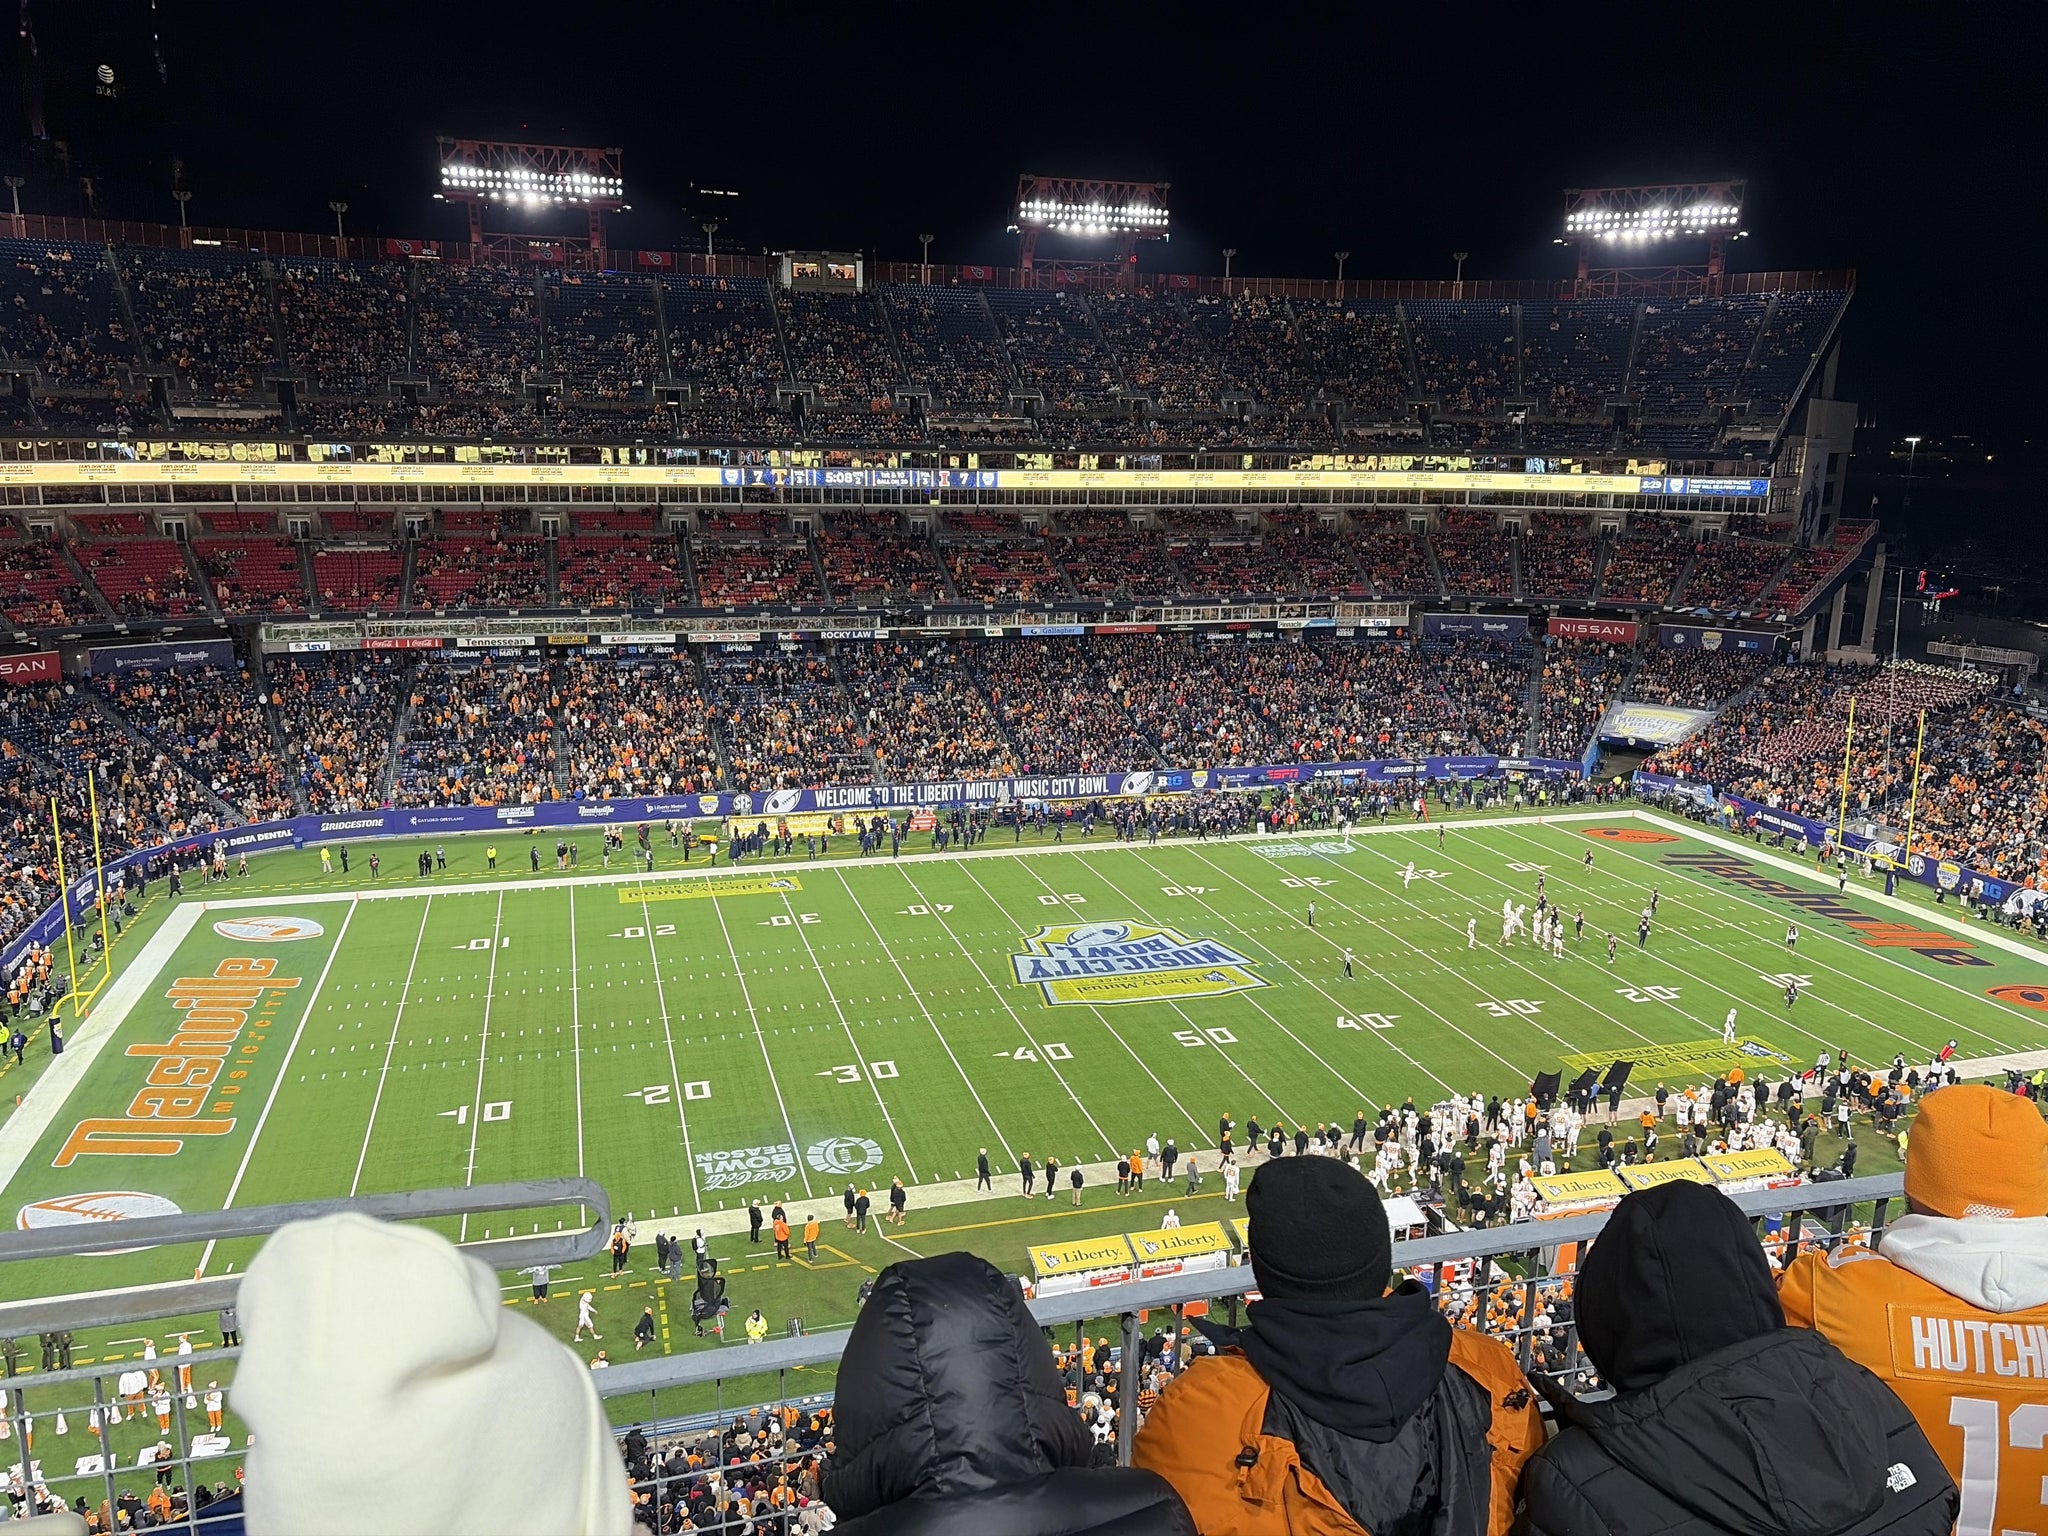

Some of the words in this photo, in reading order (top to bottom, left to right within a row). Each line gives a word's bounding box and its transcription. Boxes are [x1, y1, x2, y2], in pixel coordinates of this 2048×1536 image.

[753, 470, 763, 482] 7
[825, 472, 853, 483] 5:08
[959, 472, 969, 485] 7
[821, 631, 850, 639] ROCKY
[852, 631, 871, 639] LAW
[1042, 627, 1075, 635] Gallagher
[1559, 623, 1625, 636] NISSAN
[1267, 769, 1299, 780] ESPN
[815, 787, 870, 808] WELCOME
[871, 787, 889, 804] TO
[892, 785, 914, 803] THE
[918, 782, 962, 802] LIBERTY
[1013, 778, 1049, 797] MUSIC
[1052, 777, 1075, 796] CITY
[1079, 776, 1109, 794] BOWL
[735, 798, 750, 808] SEC
[320, 819, 384, 832] BRIDGESTONE
[1763, 814, 1782, 826] DELTA
[1782, 819, 1805, 833] DENTAL
[230, 833, 257, 847] DELTA
[257, 829, 293, 842] DENTAL
[1911, 859, 1924, 872] SEC
[1056, 938, 1169, 958] BOWL
[1117, 944, 1236, 970] MUSIC
[1029, 957, 1115, 979] CITY
[1077, 981, 1138, 994] Mutual
[1140, 976, 1202, 990] Liberty
[1615, 985, 1675, 1002] 20
[1476, 999, 1540, 1017] 30
[1336, 1012, 1396, 1030] 40
[1171, 1027, 1239, 1048] 50
[211, 1044, 260, 1114] MUSIC
[254, 990, 287, 1029] CITY
[1012, 1042, 1075, 1063] 40
[51, 957, 302, 1167] Nashville
[832, 1060, 900, 1084] 30
[643, 1080, 712, 1105] 20
[457, 1101, 513, 1125] 10
[695, 1144, 792, 1163] SEASON
[696, 1152, 795, 1174] BOWL
[1732, 1156, 1780, 1172] Liberty
[700, 1165, 797, 1192] Coca-Cola
[1651, 1168, 1699, 1183] Liberty
[1562, 1179, 1613, 1194] Liberty
[1161, 1232, 1217, 1251] Liberty
[1063, 1246, 1120, 1264] Liberty
